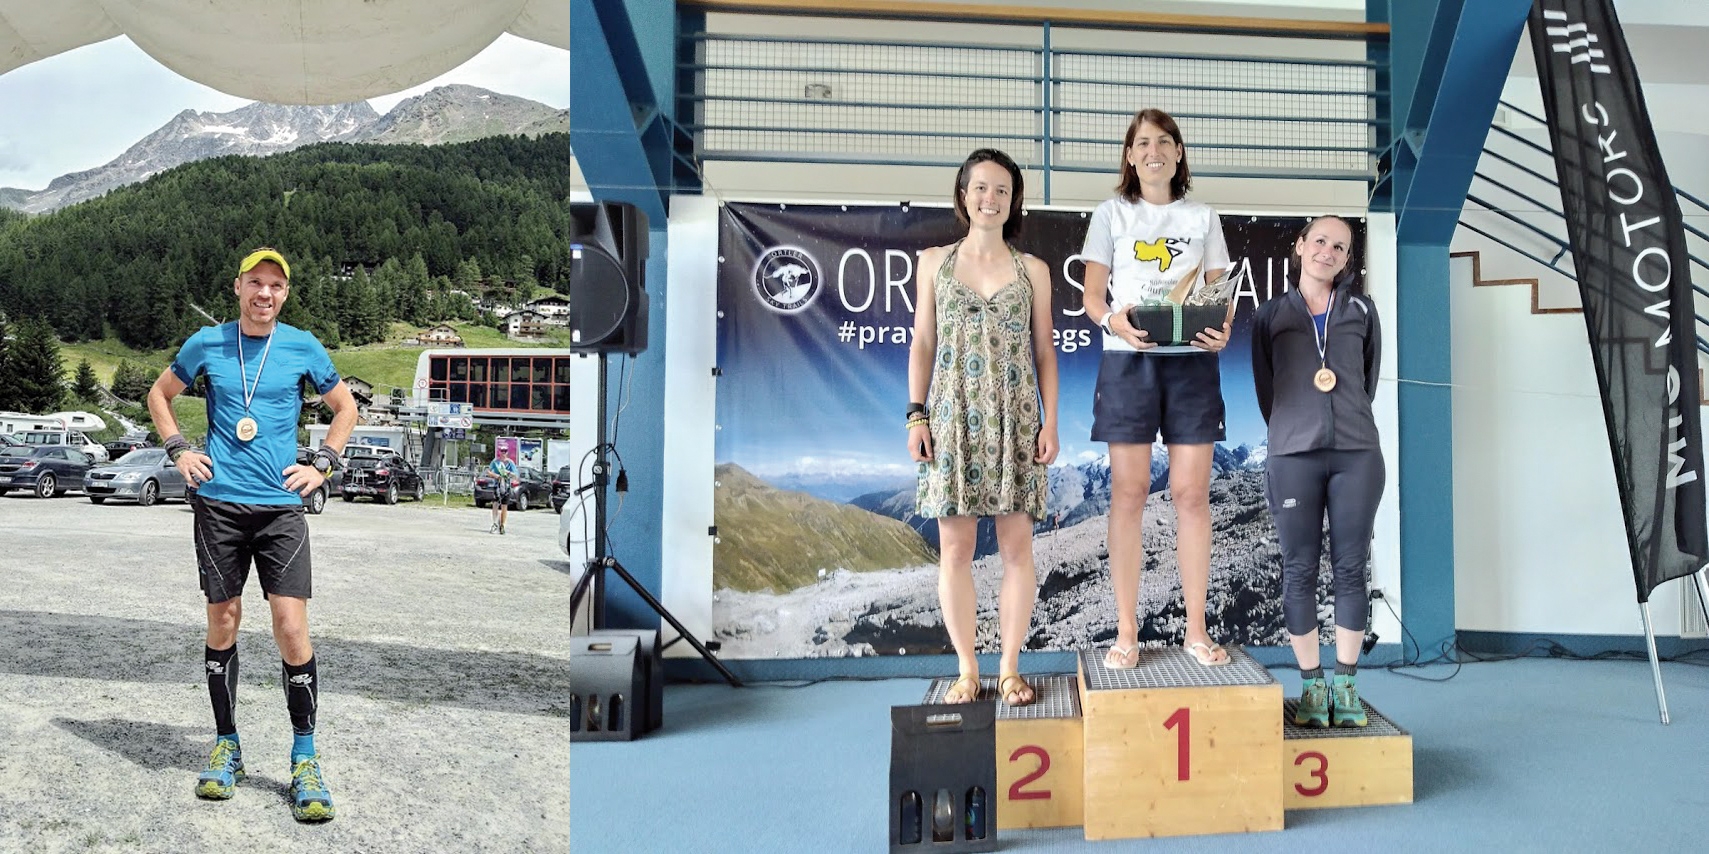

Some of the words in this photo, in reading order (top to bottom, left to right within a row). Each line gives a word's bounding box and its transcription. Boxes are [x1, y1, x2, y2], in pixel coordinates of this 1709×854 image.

[771, 250, 803, 259] ORTLER
[1162, 707, 1190, 781] 1
[1008, 744, 1051, 800] 2
[1294, 750, 1329, 797] 3
